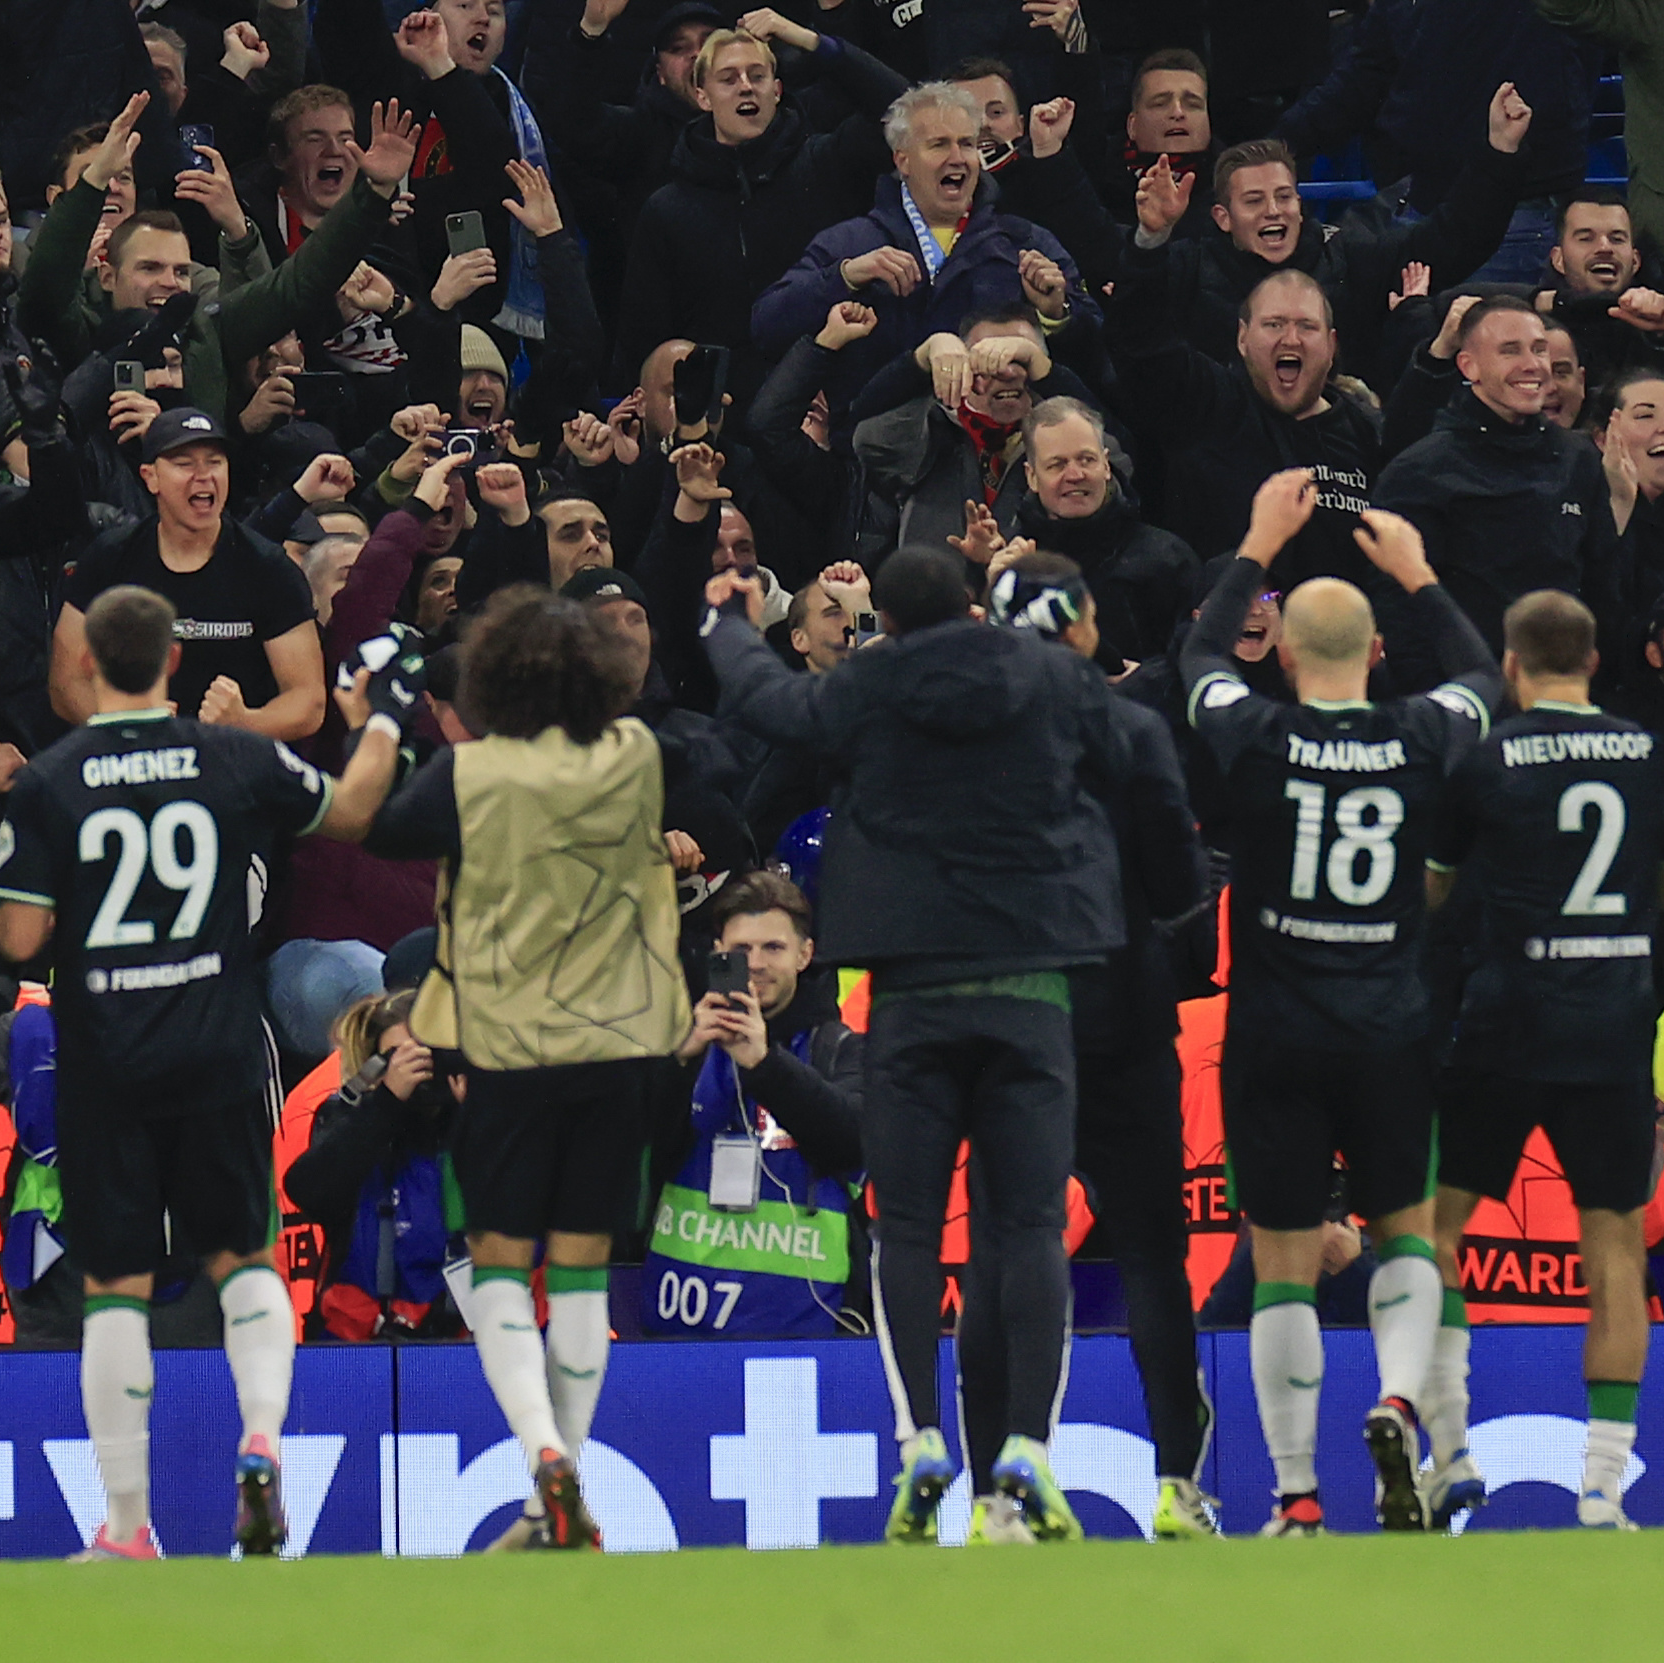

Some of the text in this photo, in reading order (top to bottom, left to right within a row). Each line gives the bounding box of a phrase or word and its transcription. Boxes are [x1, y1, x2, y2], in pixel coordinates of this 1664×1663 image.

[82, 746, 200, 788] GIMENEZ
[1288, 734, 1407, 772] TRAUNER
[1502, 732, 1654, 768] NIEUWKOOP
[1285, 778, 1405, 906] 18
[1557, 781, 1627, 916] 2
[78, 799, 219, 950] 29
[679, 1210, 827, 1262] CHANNEL
[658, 1270, 743, 1330] 007
